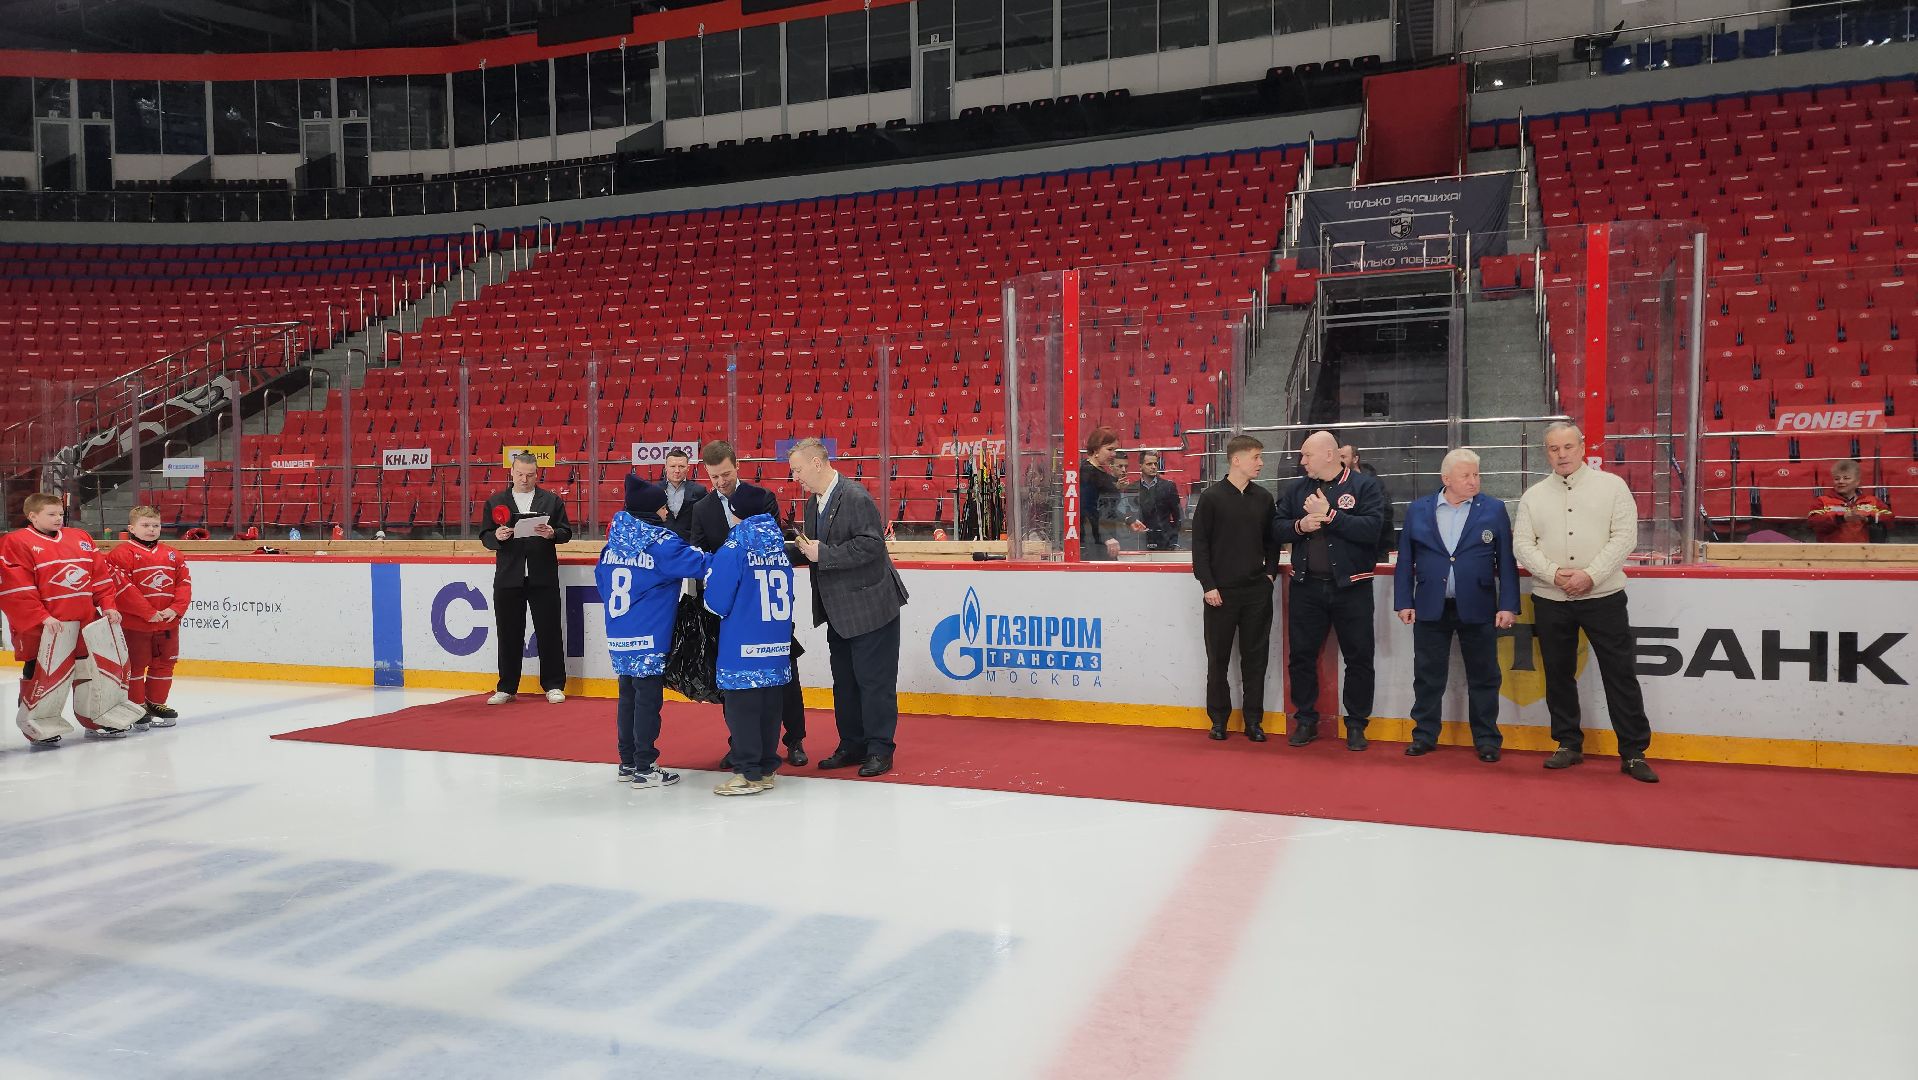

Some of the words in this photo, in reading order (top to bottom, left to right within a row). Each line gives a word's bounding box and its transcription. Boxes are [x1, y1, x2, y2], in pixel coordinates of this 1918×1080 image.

[1346, 197, 1391, 209] ТОЛЬКО
[1396, 192, 1461, 203] БАЛАШИХА!
[1776, 410, 1882, 430] FONBET
[271, 460, 314, 468] OLIMPBET
[385, 453, 428, 465] KHL.RU
[1065, 470, 1078, 540] RAITA
[609, 568, 632, 618] 8
[754, 569, 791, 621] 13
[191, 601, 219, 611] тема
[223, 597, 282, 616] быстрых
[180, 614, 229, 629] атежей
[985, 615, 1102, 649] ГАЗПРОМ
[989, 651, 1099, 669] ТРАНСГАЗ
[1630, 626, 1909, 686] БАНК
[986, 670, 1102, 687] МОСКВА
